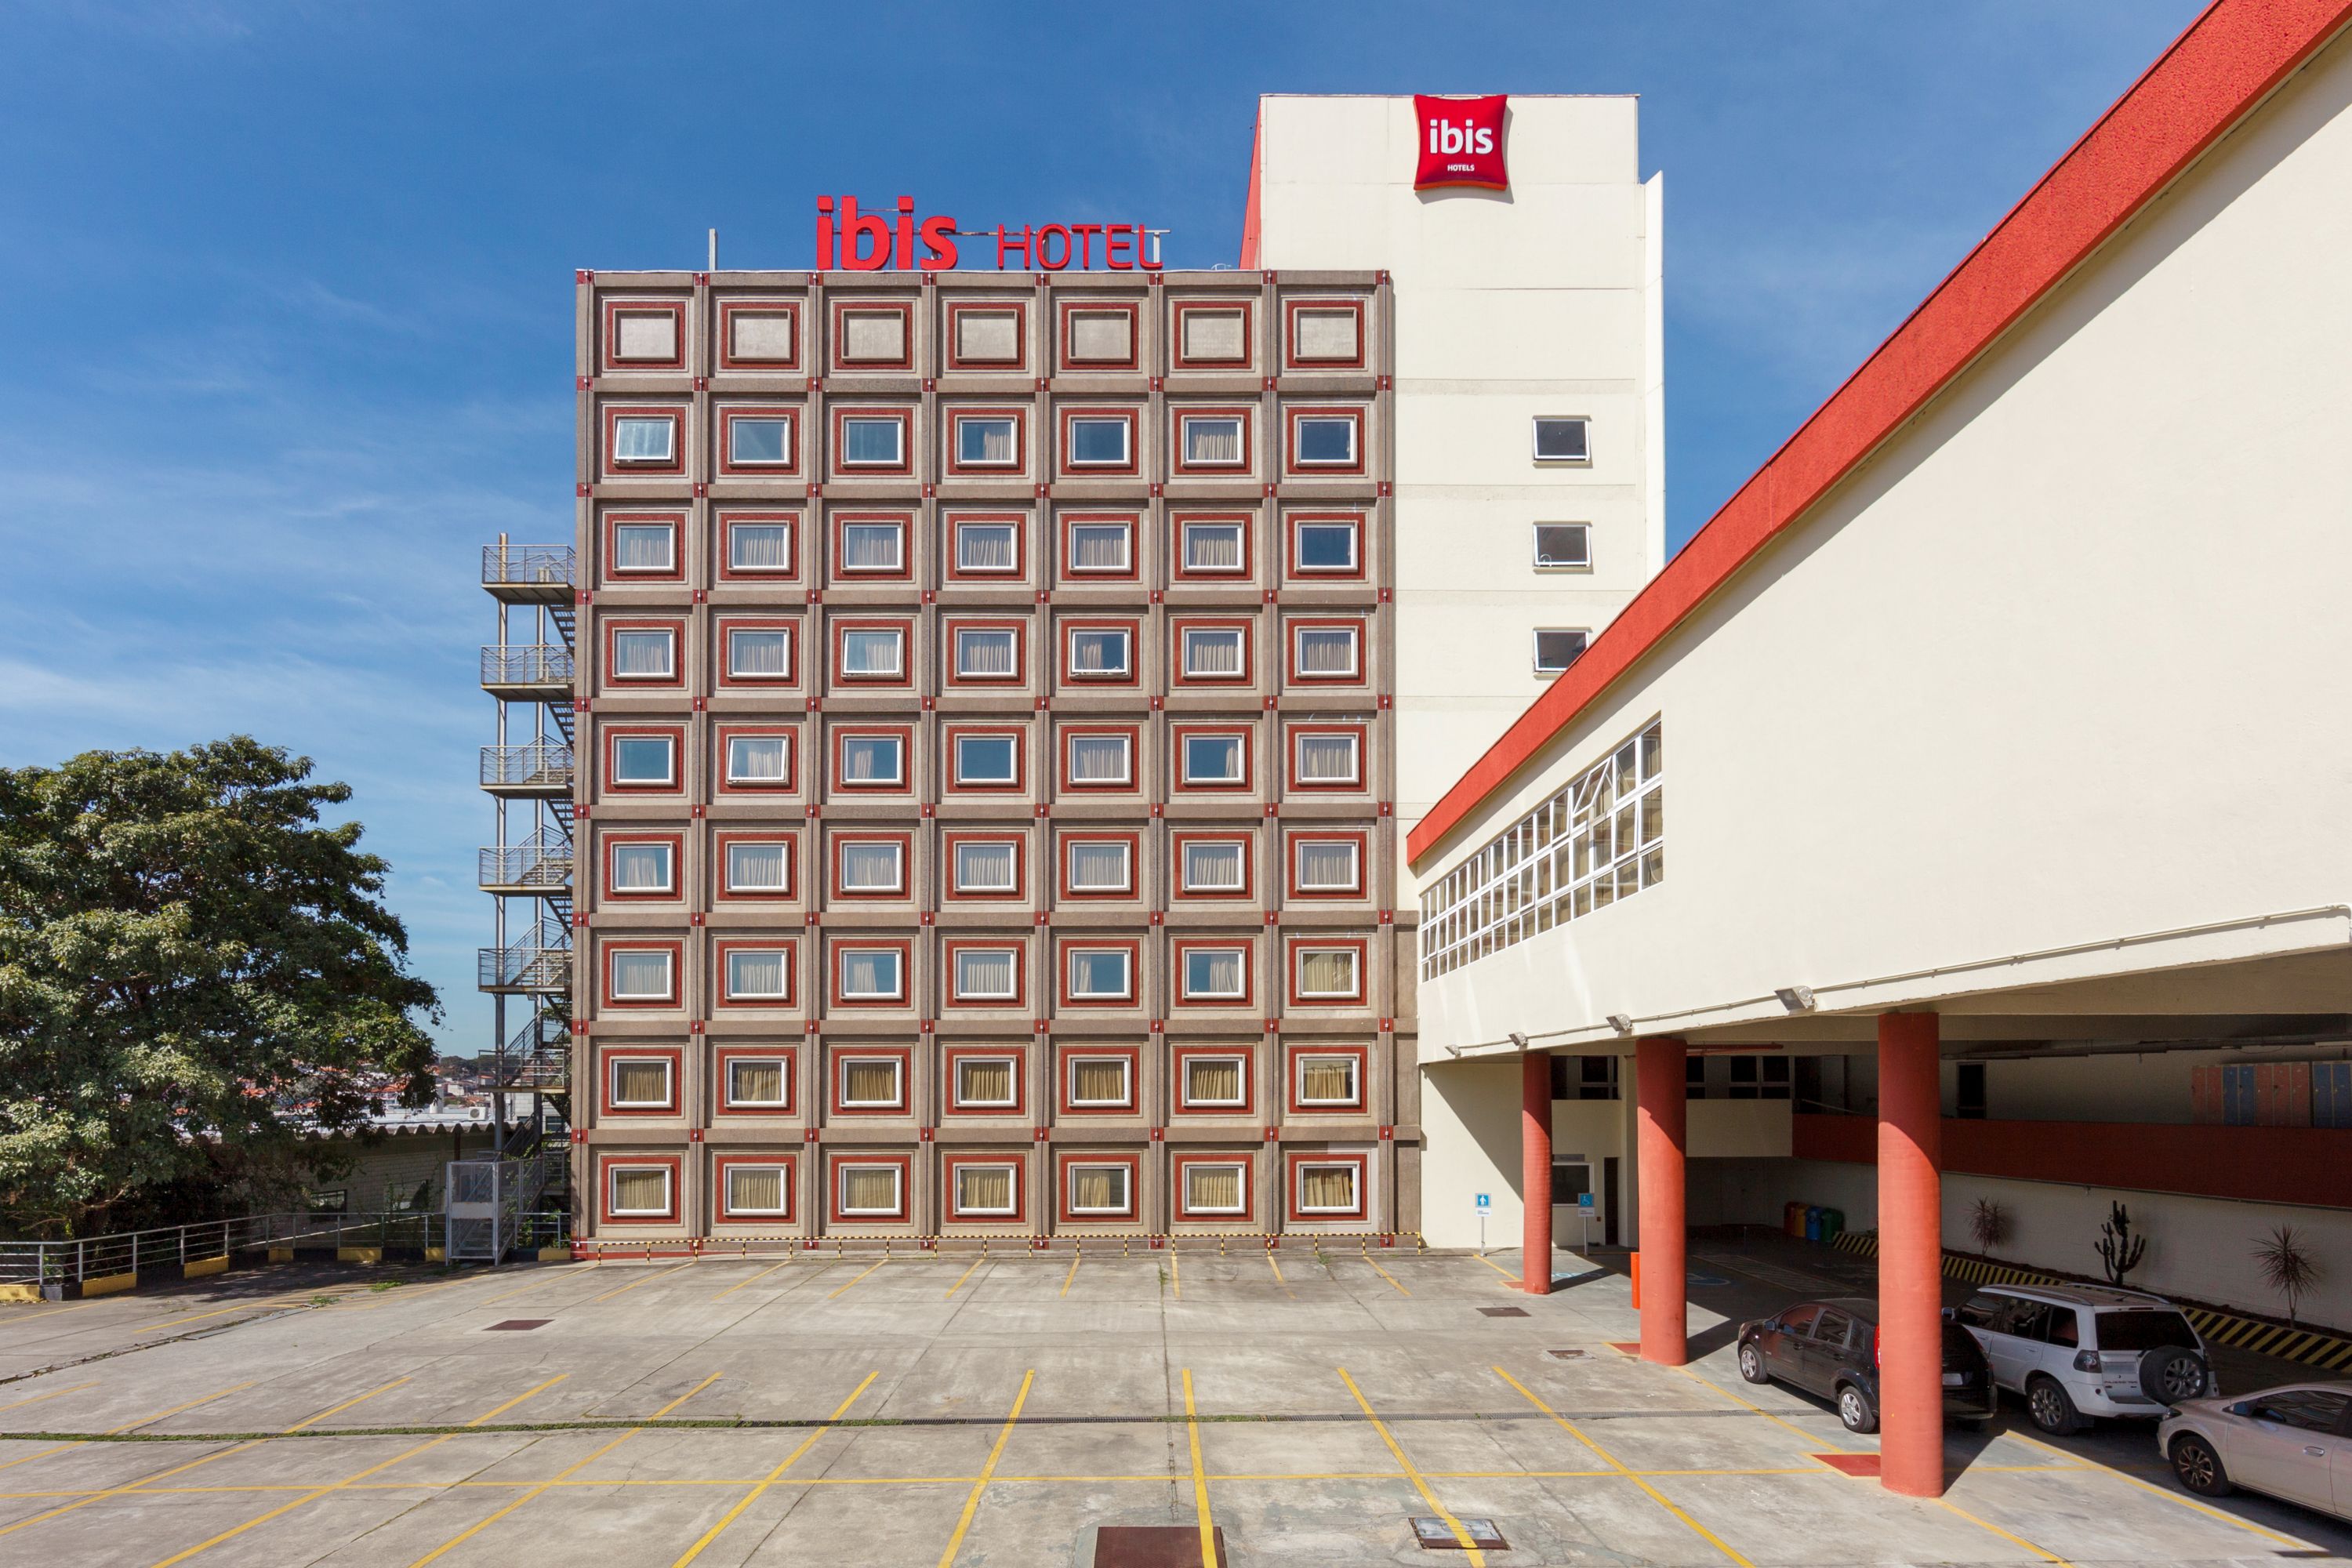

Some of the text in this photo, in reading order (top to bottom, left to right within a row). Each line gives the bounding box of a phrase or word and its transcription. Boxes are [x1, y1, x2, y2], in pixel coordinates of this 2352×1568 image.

[1429, 118, 1494, 154] ibis
[817, 195, 1163, 270] ibis HOTEL
